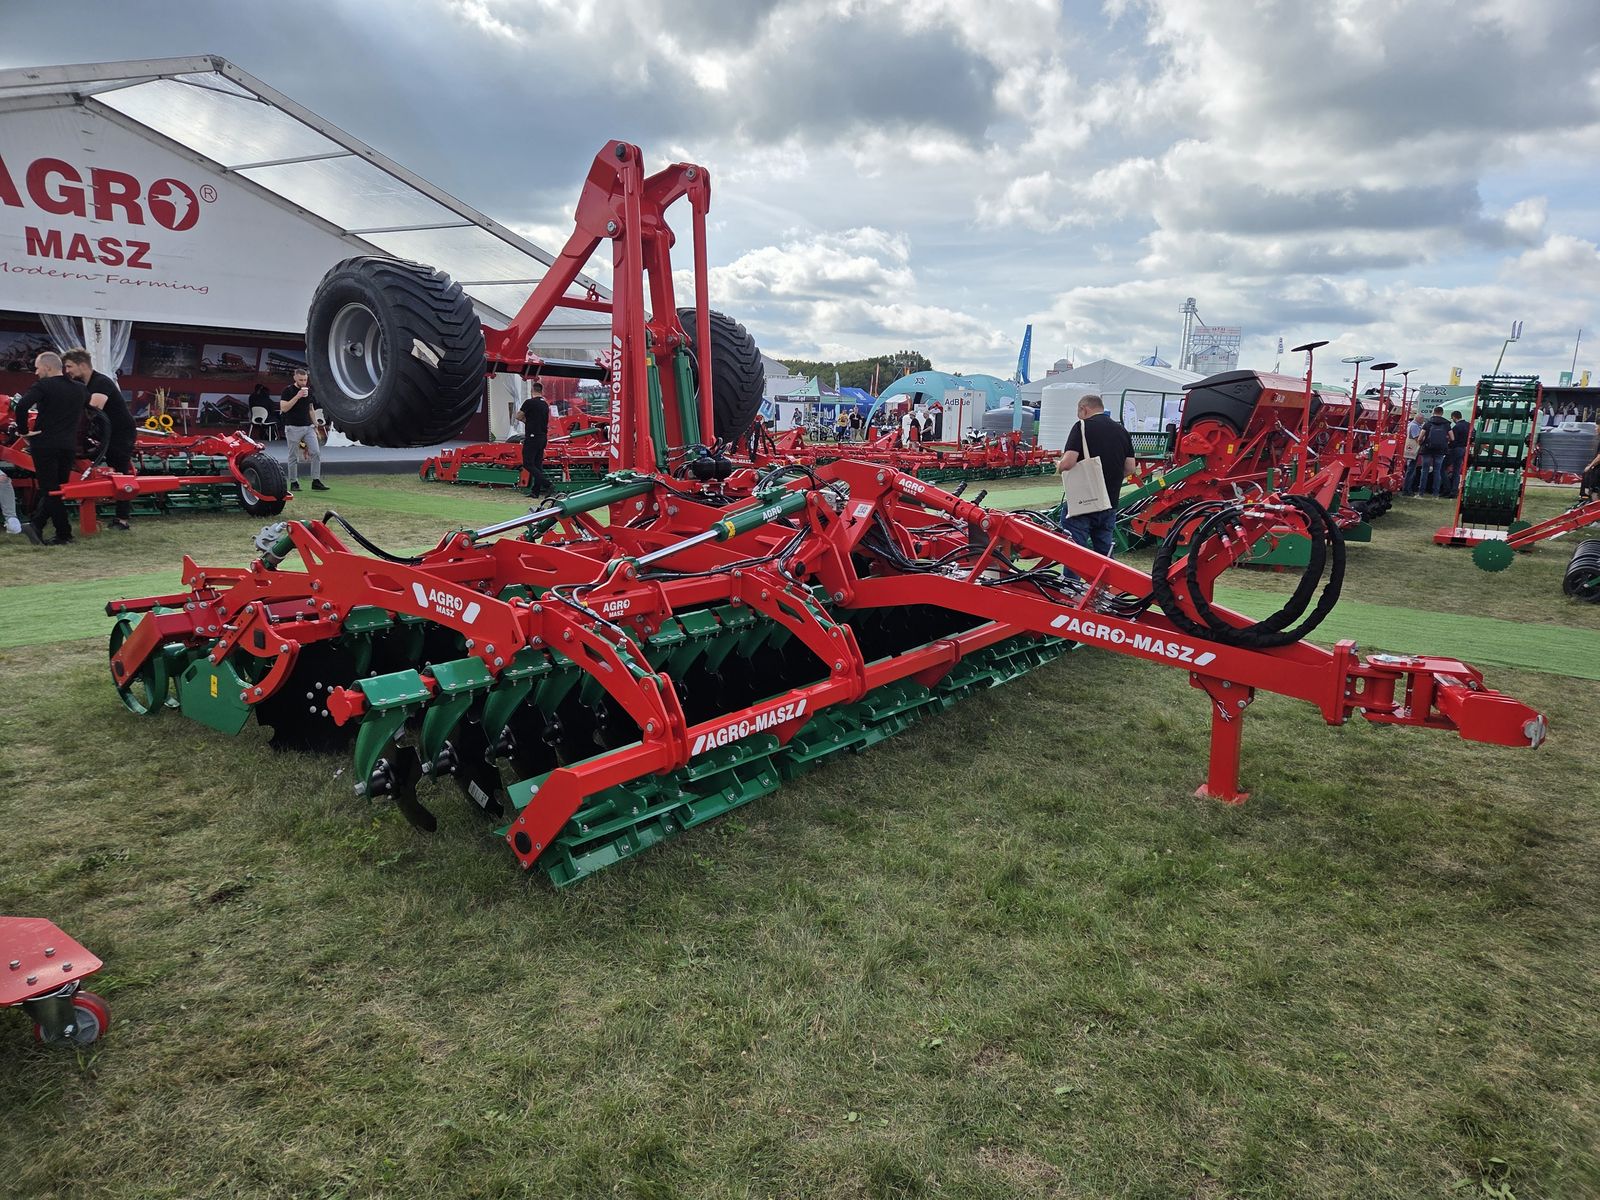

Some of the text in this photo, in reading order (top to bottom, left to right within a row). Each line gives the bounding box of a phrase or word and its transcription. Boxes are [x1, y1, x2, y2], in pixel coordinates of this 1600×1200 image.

[25, 226, 152, 269] MASZ
[106, 274, 209, 295] Farming
[611, 348, 622, 443] AGRO-MASZ
[945, 398, 971, 406] AdBue
[898, 478, 926, 494] AGRO
[762, 505, 783, 521] AGRO
[429, 588, 463, 611] AGRO
[602, 598, 630, 613] AGRO
[436, 605, 455, 618] MASZ
[609, 610, 624, 618] MASZ
[1067, 618, 1195, 663] AGRO-MASZ
[705, 703, 795, 752] AGRO-MASZ
